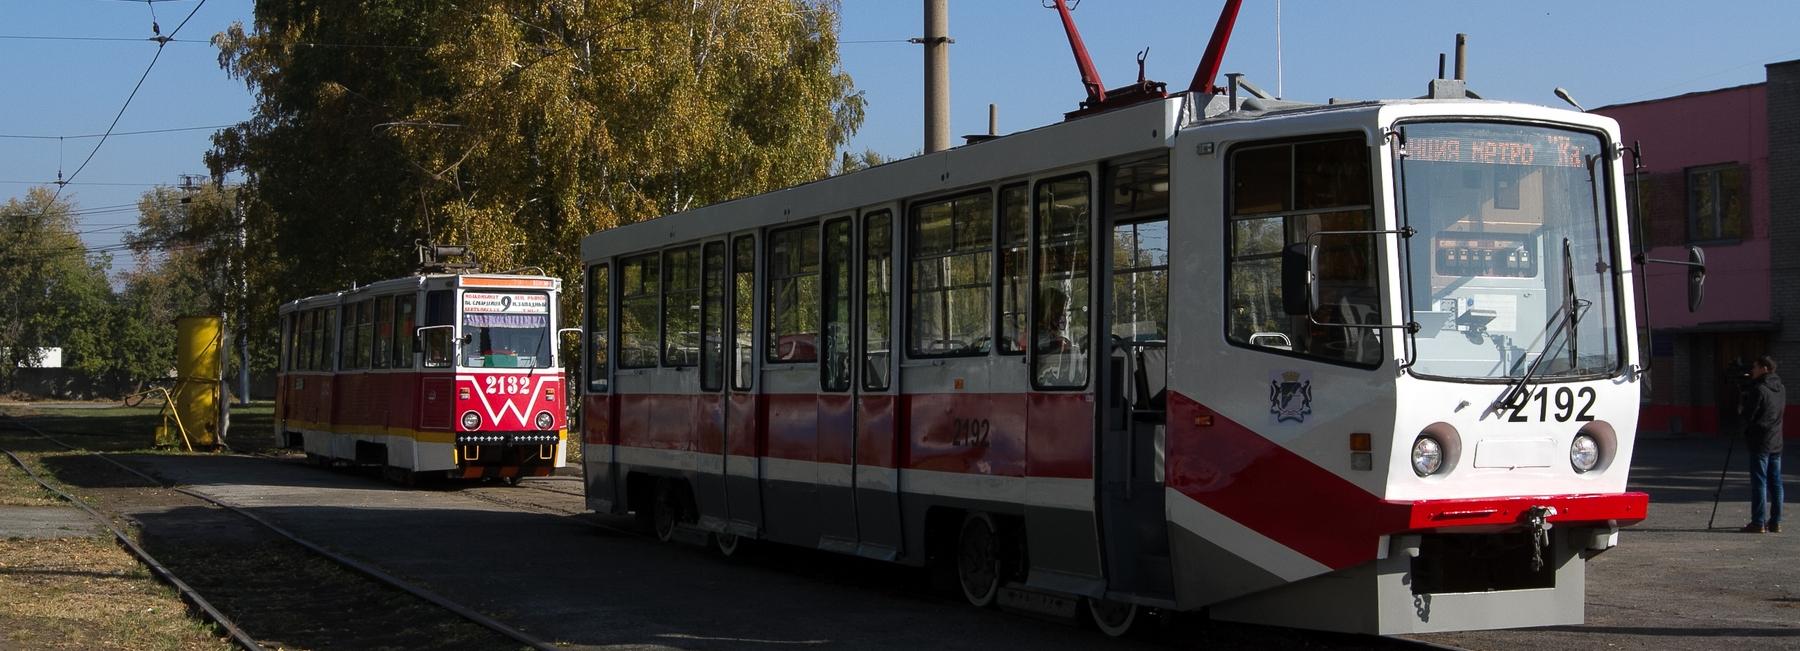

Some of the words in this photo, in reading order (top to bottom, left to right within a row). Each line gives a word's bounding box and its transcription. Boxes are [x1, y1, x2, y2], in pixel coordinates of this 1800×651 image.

[1403, 138, 1460, 161] нция
[501, 296, 512, 312] 9
[486, 375, 530, 395] 2132
[1508, 386, 1597, 422] 2192
[952, 416, 991, 448] 2192
